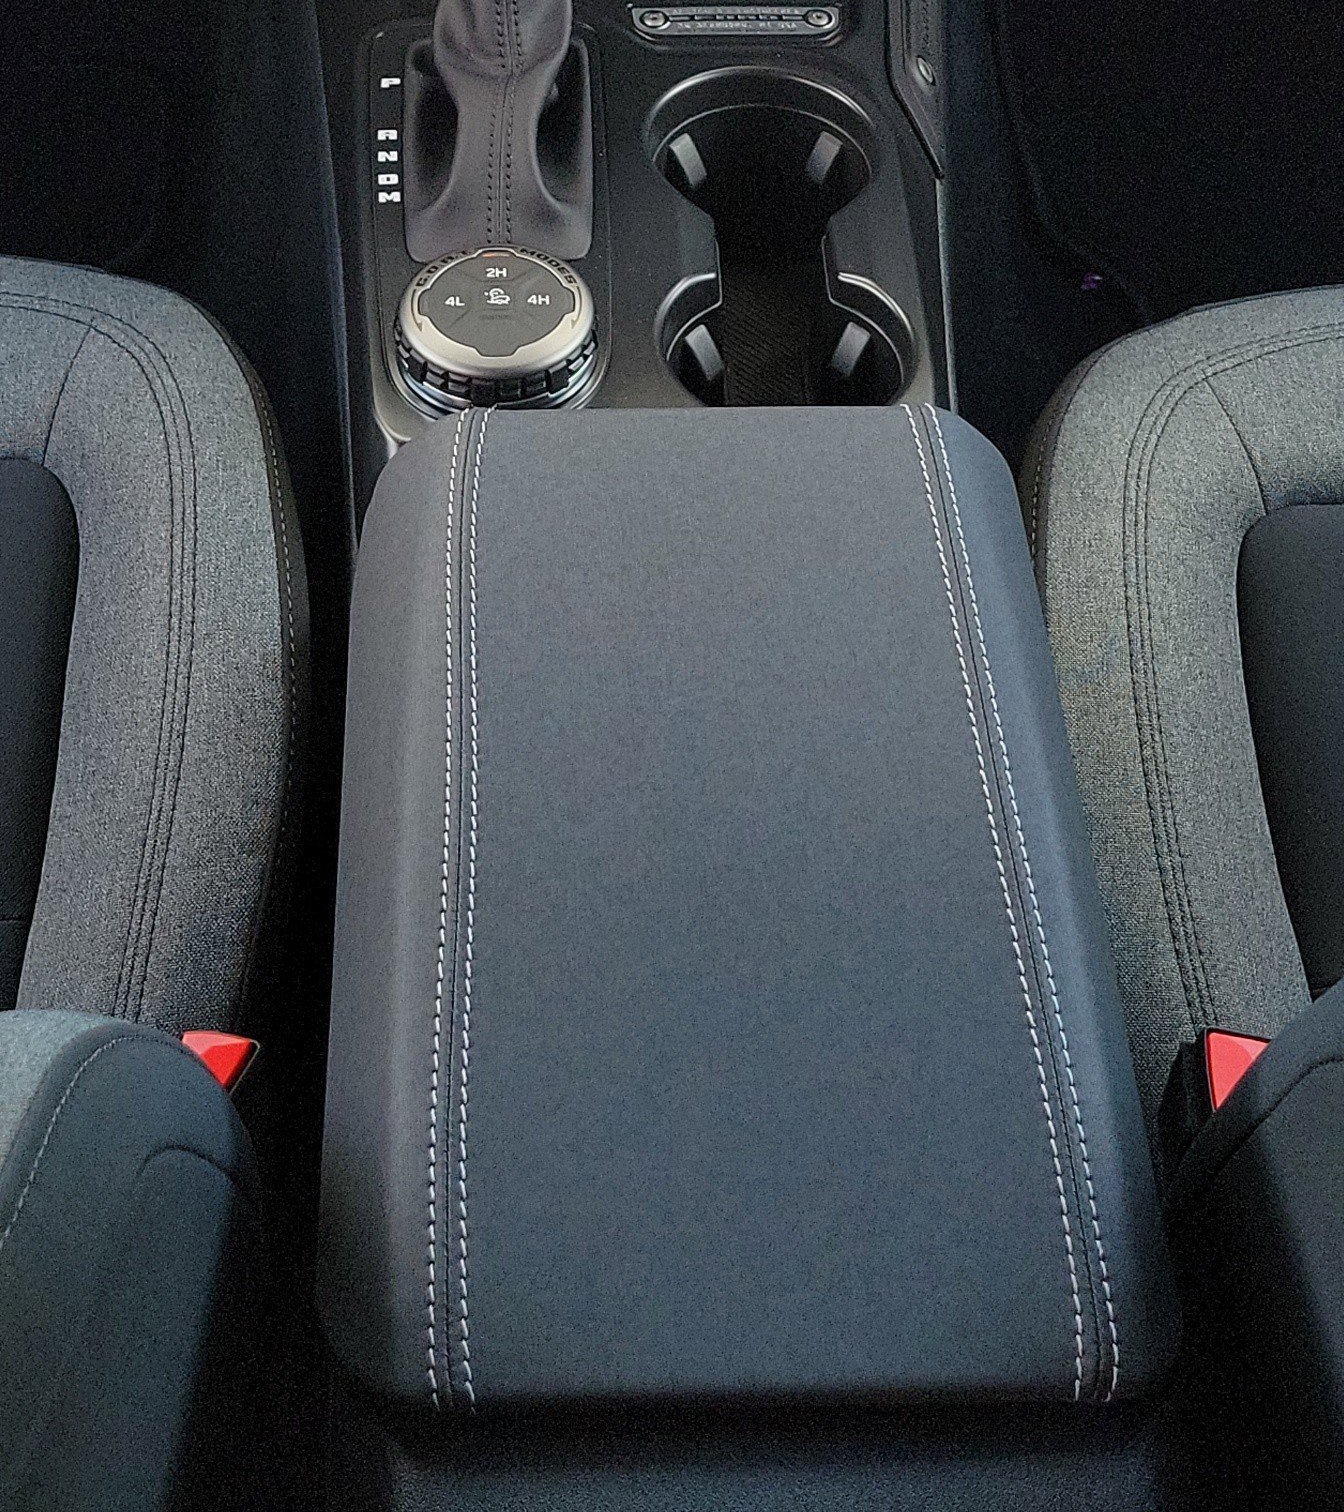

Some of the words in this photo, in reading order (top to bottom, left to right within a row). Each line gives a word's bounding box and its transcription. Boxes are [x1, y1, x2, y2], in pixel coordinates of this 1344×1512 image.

[380, 77, 401, 88] P
[377, 150, 398, 162] N
[378, 191, 401, 203] M
[519, 247, 578, 285] MODES
[485, 267, 508, 278] 2H
[444, 296, 465, 307] 4L
[527, 294, 550, 306] 4H
